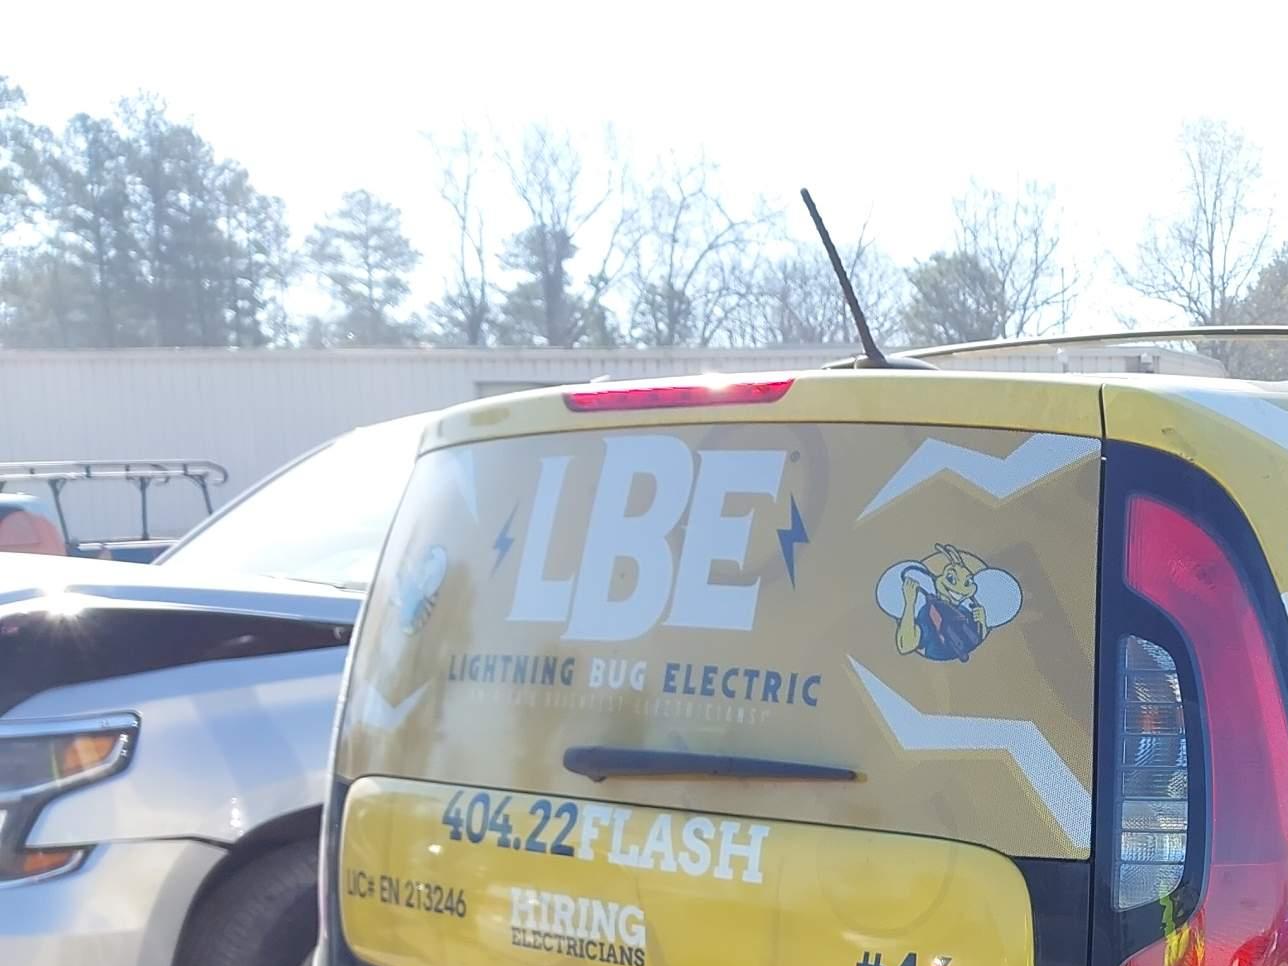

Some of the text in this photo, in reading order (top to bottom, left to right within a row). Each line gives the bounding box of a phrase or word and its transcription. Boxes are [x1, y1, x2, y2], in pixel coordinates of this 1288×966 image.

[504, 433, 787, 641] LBE
[449, 654, 576, 687] LIGHTNING
[588, 656, 648, 691] BUG
[662, 662, 822, 707] ELECTRIC
[346, 869, 467, 919] LIC# EN 213246
[511, 886, 647, 946] HIRING
